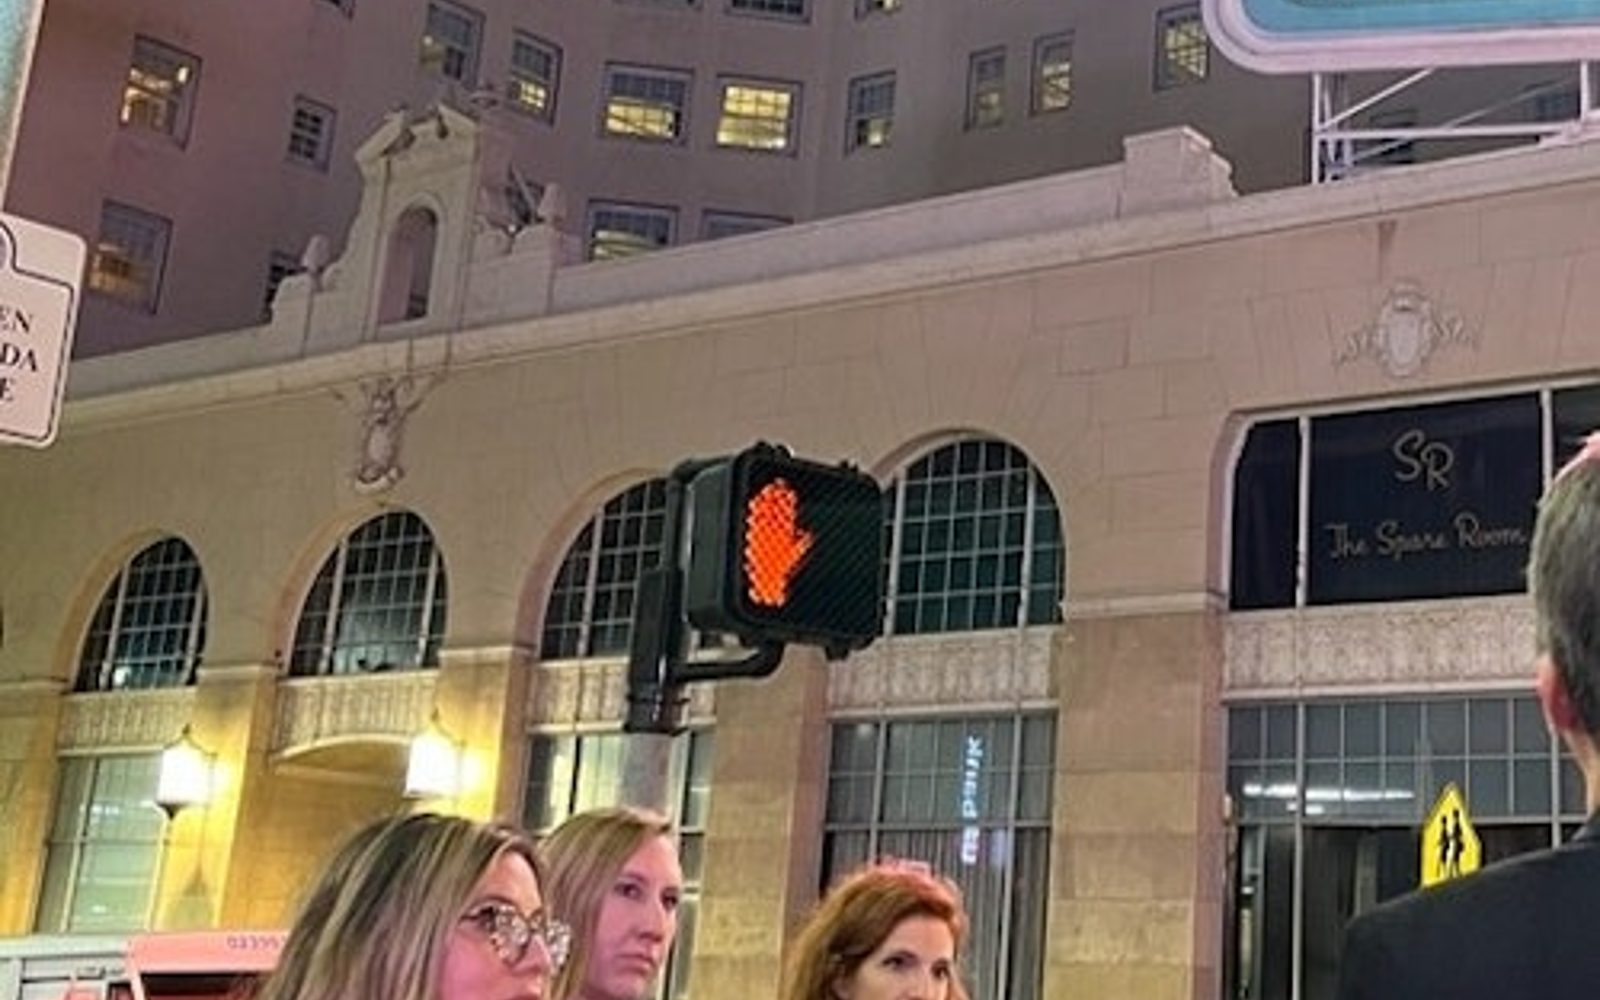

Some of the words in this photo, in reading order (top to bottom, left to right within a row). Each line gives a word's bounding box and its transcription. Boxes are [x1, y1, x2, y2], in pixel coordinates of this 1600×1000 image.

[1393, 428, 1455, 491] SR
[1323, 522, 1367, 559] The
[1376, 519, 1447, 561] Spare
[1454, 511, 1528, 548] Room
